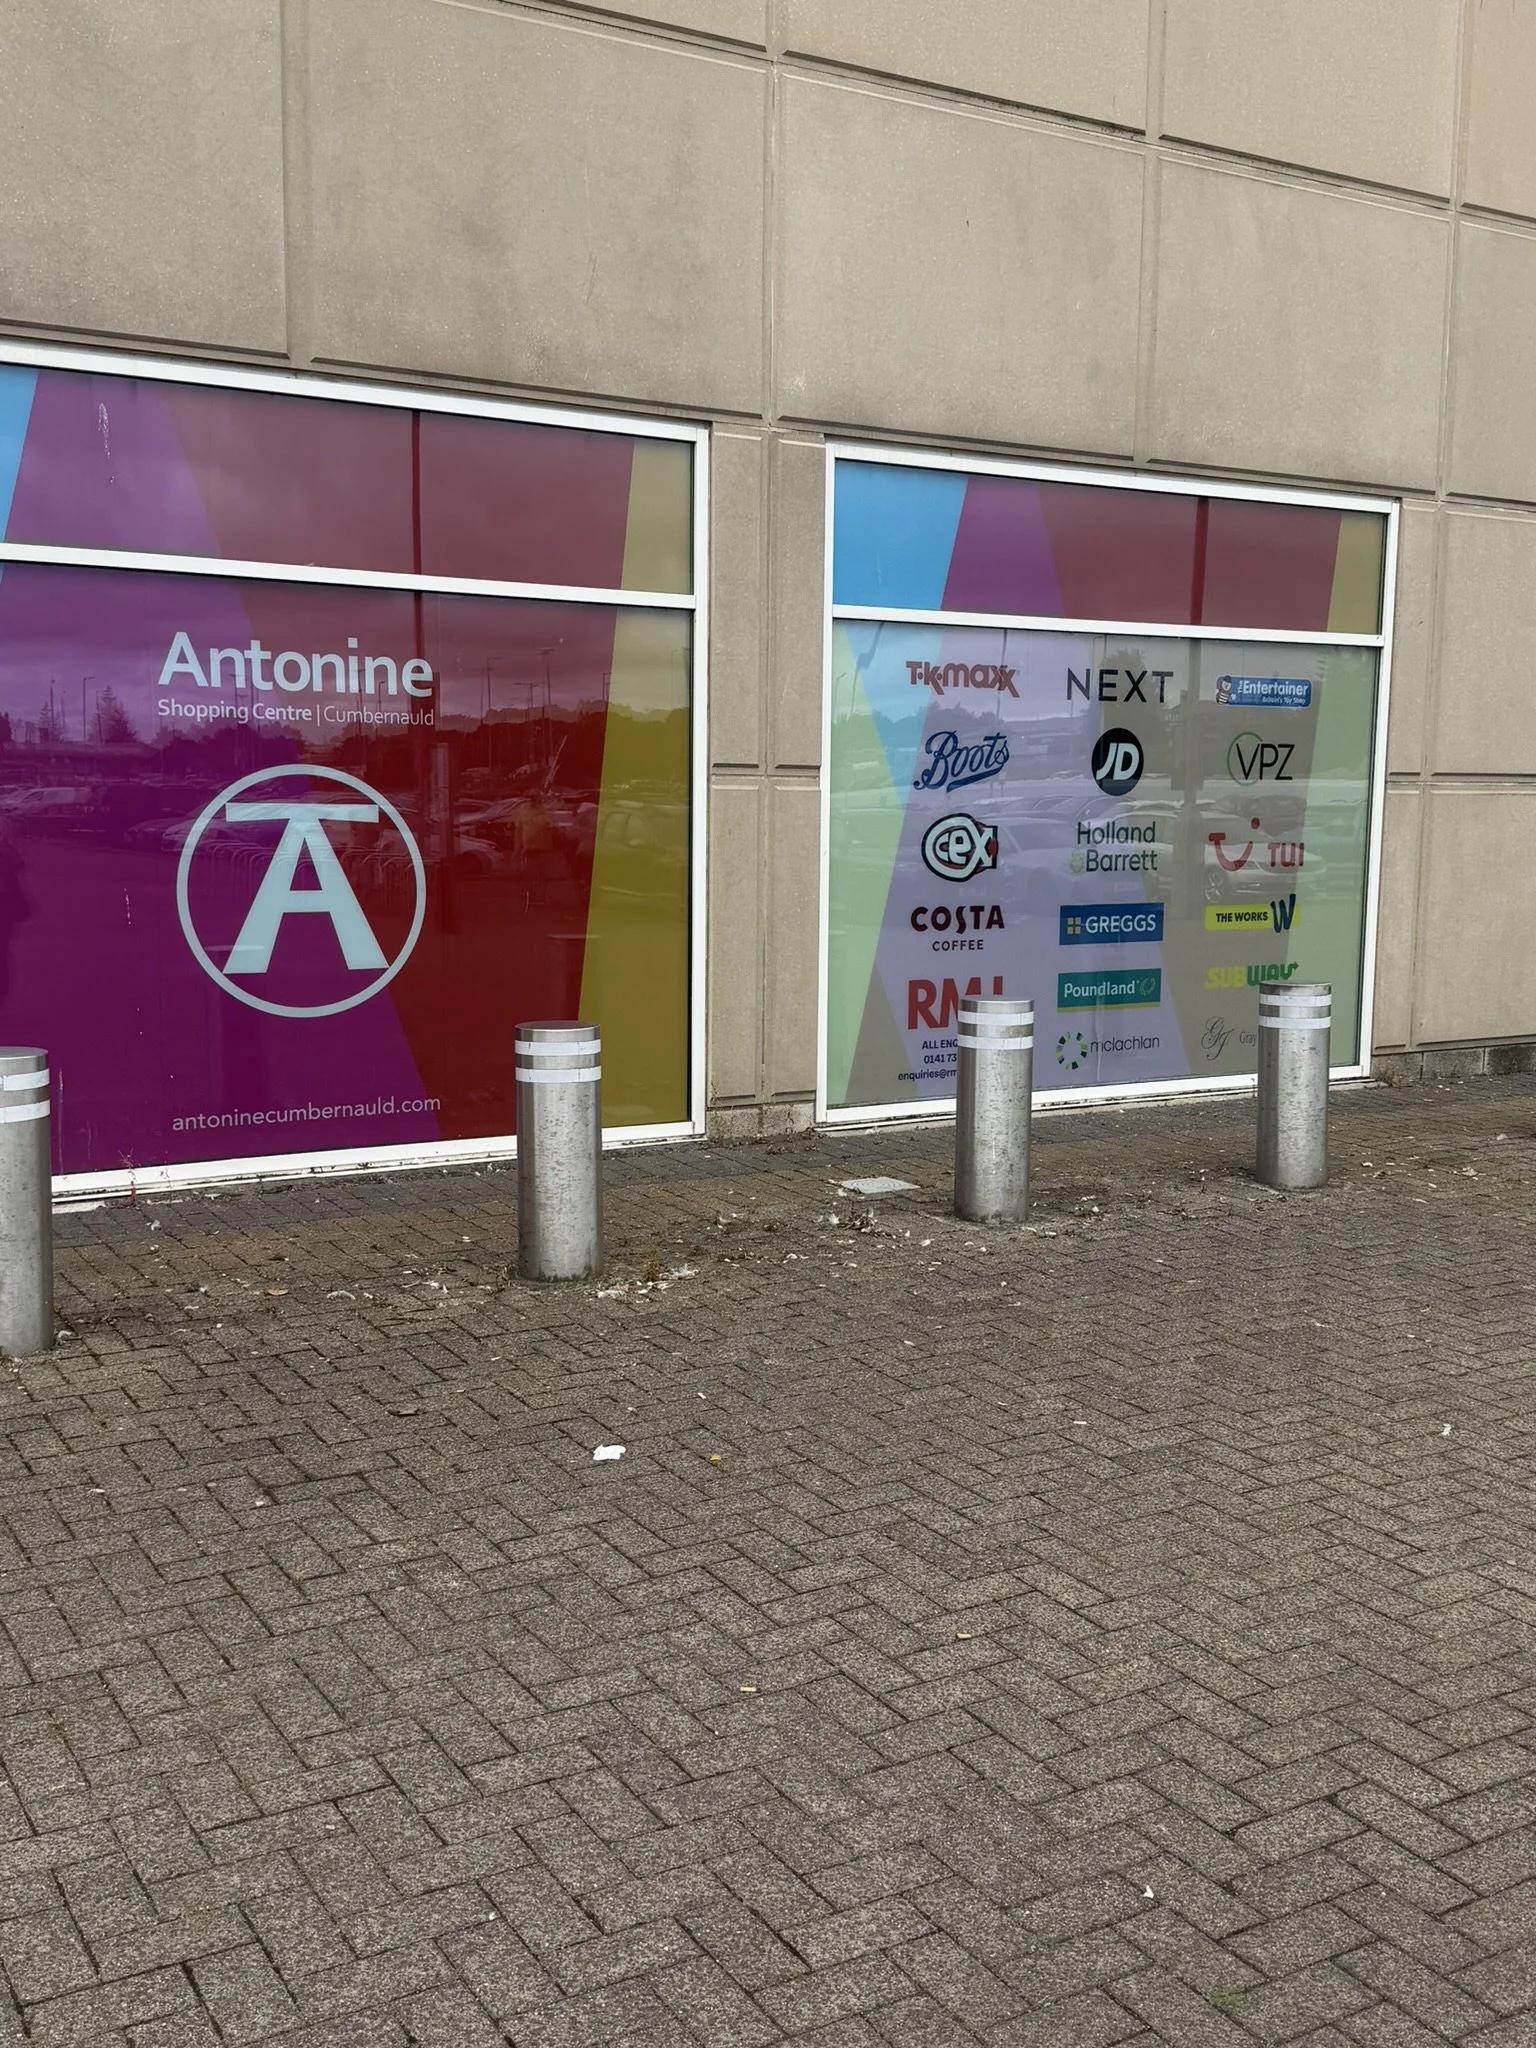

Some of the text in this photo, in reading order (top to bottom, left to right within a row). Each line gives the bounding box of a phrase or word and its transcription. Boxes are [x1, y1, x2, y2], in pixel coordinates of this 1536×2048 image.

[158, 631, 433, 697] Antonine
[1067, 667, 1174, 703] NEXT
[1243, 680, 1308, 696] Entertainer
[158, 698, 434, 726] Shopping Centre Cumbernauld
[914, 730, 1010, 793] Boots
[1095, 742, 1140, 780] JD
[1236, 743, 1295, 780] VPZ
[1077, 821, 1156, 844] Holland
[1086, 849, 1158, 872] Barrett
[910, 905, 1005, 935] COSTA
[1085, 914, 1156, 934] GREGGS
[1216, 911, 1268, 923] THE WORKS
[932, 939, 984, 951] COFFEE
[1064, 980, 1135, 998] Poundland
[922, 1040, 939, 1050] ALL
[1090, 1035, 1160, 1053] mclachlan
[923, 1054, 945, 1064] 0141
[172, 1096, 441, 1131] antoninecumbernauld.com
